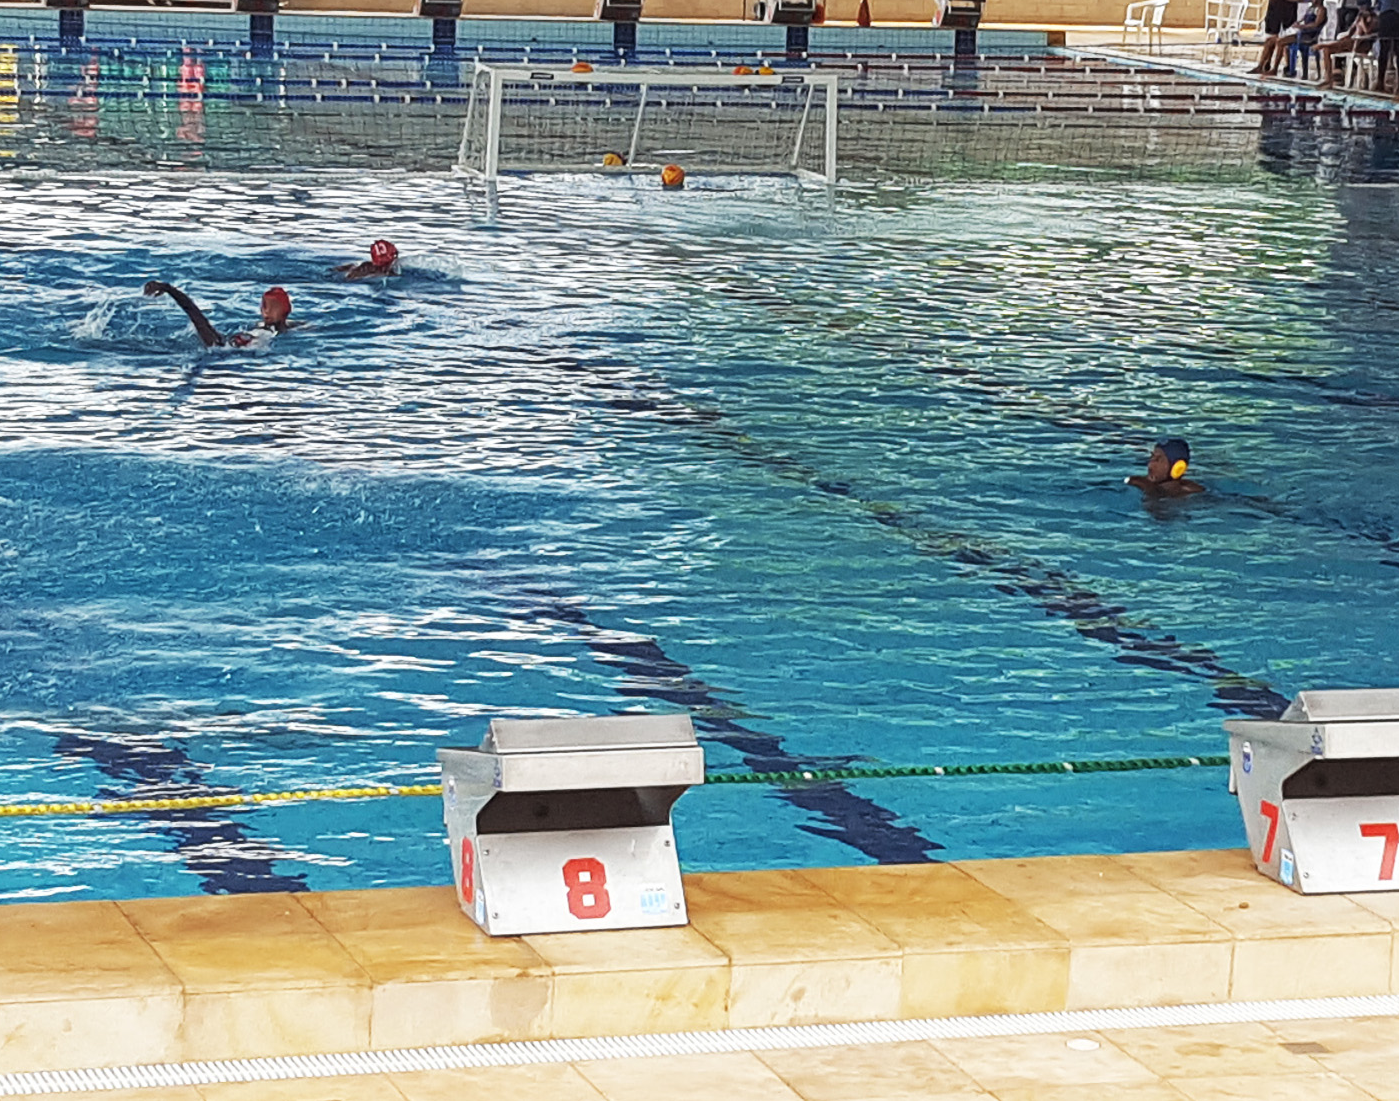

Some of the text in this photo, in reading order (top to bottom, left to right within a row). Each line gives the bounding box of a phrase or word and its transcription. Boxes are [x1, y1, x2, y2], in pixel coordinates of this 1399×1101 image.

[1260, 800, 1279, 863] 7
[1359, 823, 1399, 880] 7
[461, 836, 474, 904] 8
[562, 857, 611, 919] 8
